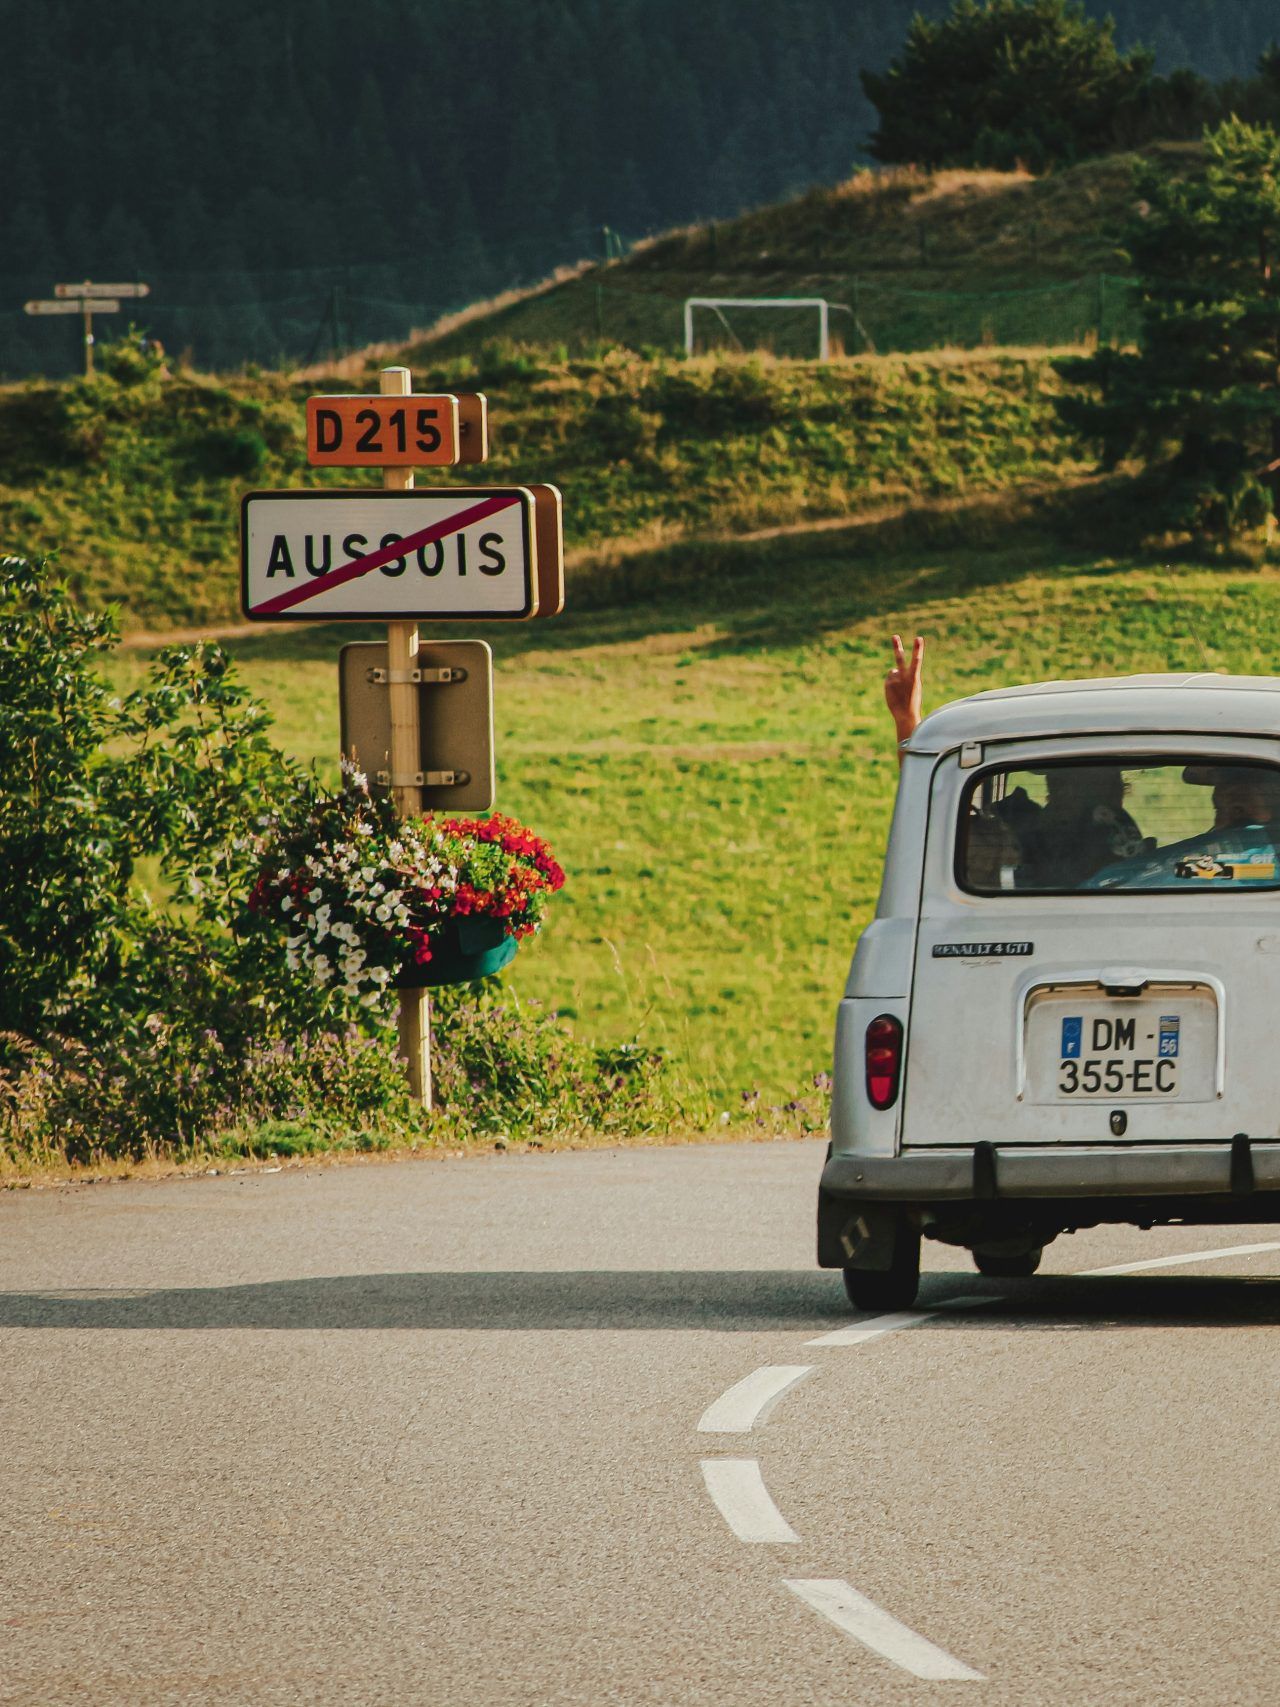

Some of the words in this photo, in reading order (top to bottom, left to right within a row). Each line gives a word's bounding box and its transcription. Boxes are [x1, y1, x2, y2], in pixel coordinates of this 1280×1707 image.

[315, 408, 343, 453] D
[355, 408, 443, 454] 215
[266, 532, 507, 579] AUSSOIS
[994, 943, 1004, 954] 4
[1066, 1042, 1077, 1055] F
[1161, 1038, 1178, 1056] 56
[1059, 1059, 1176, 1094] 355-EC
